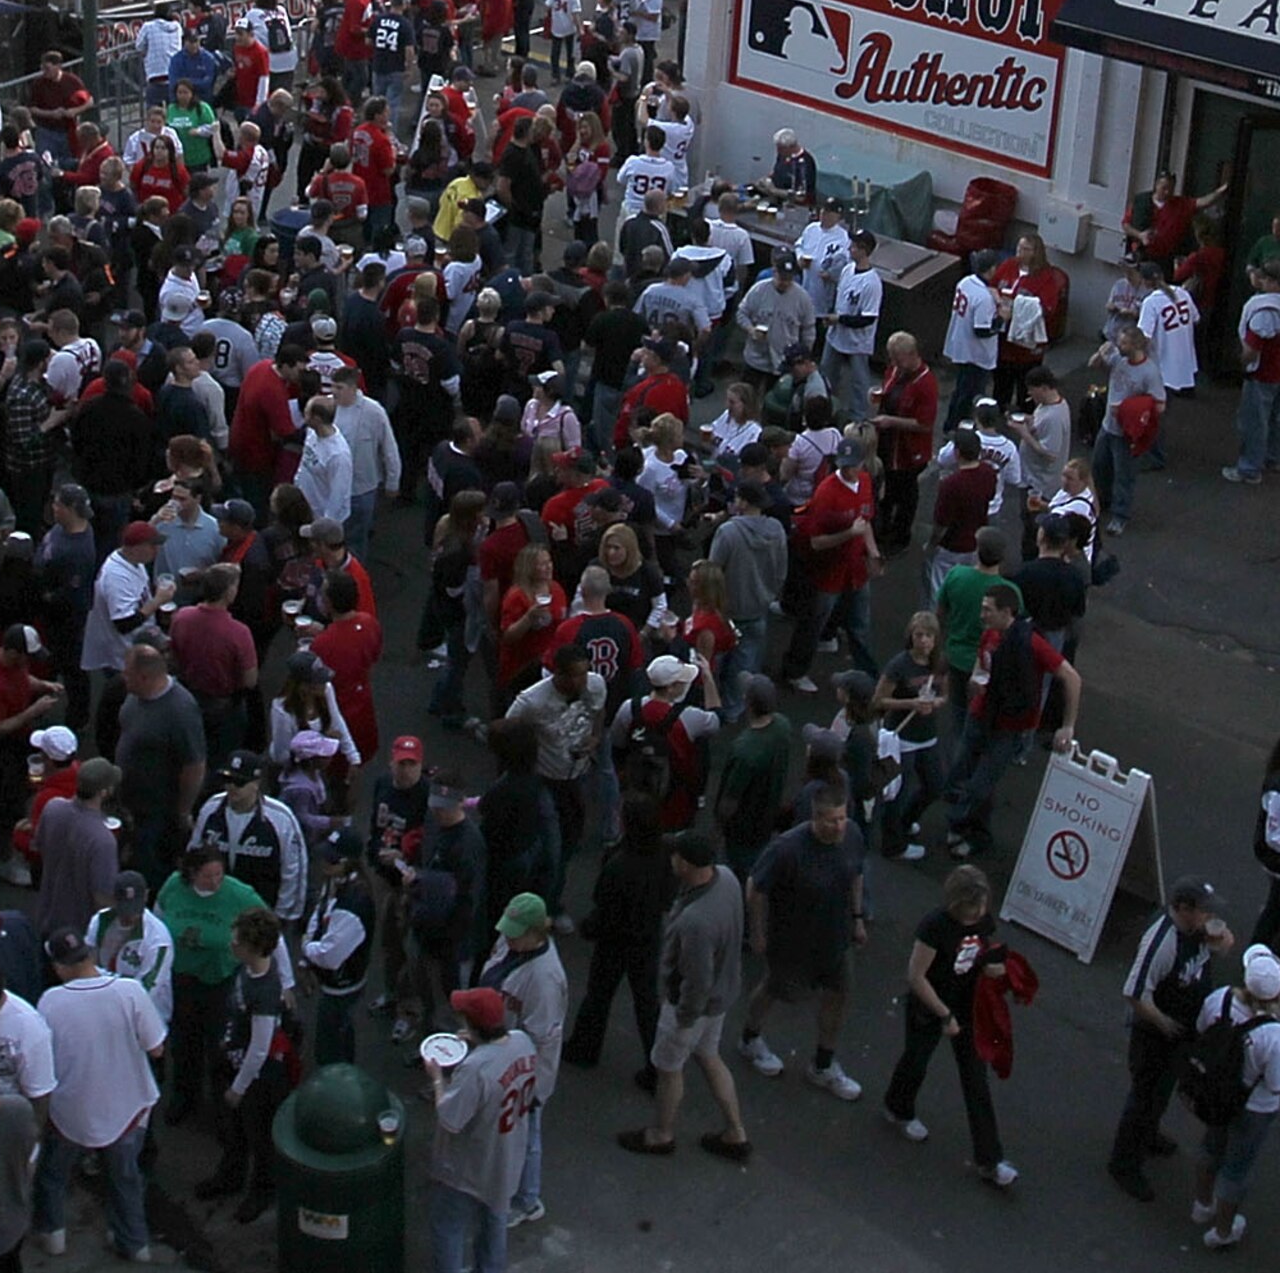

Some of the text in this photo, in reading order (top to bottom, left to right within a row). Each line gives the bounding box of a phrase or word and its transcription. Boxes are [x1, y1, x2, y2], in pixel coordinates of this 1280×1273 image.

[376, 30, 399, 52] 24
[835, 31, 1048, 112] Authentic
[922, 110, 1038, 157] COLLECTION
[633, 174, 667, 196] 33
[1161, 300, 1190, 332] 25
[215, 339, 231, 369] 8
[584, 636, 619, 680] B
[1043, 797, 1122, 843] SMOKING
[1074, 791, 1101, 812] NO
[498, 1075, 536, 1135] 20
